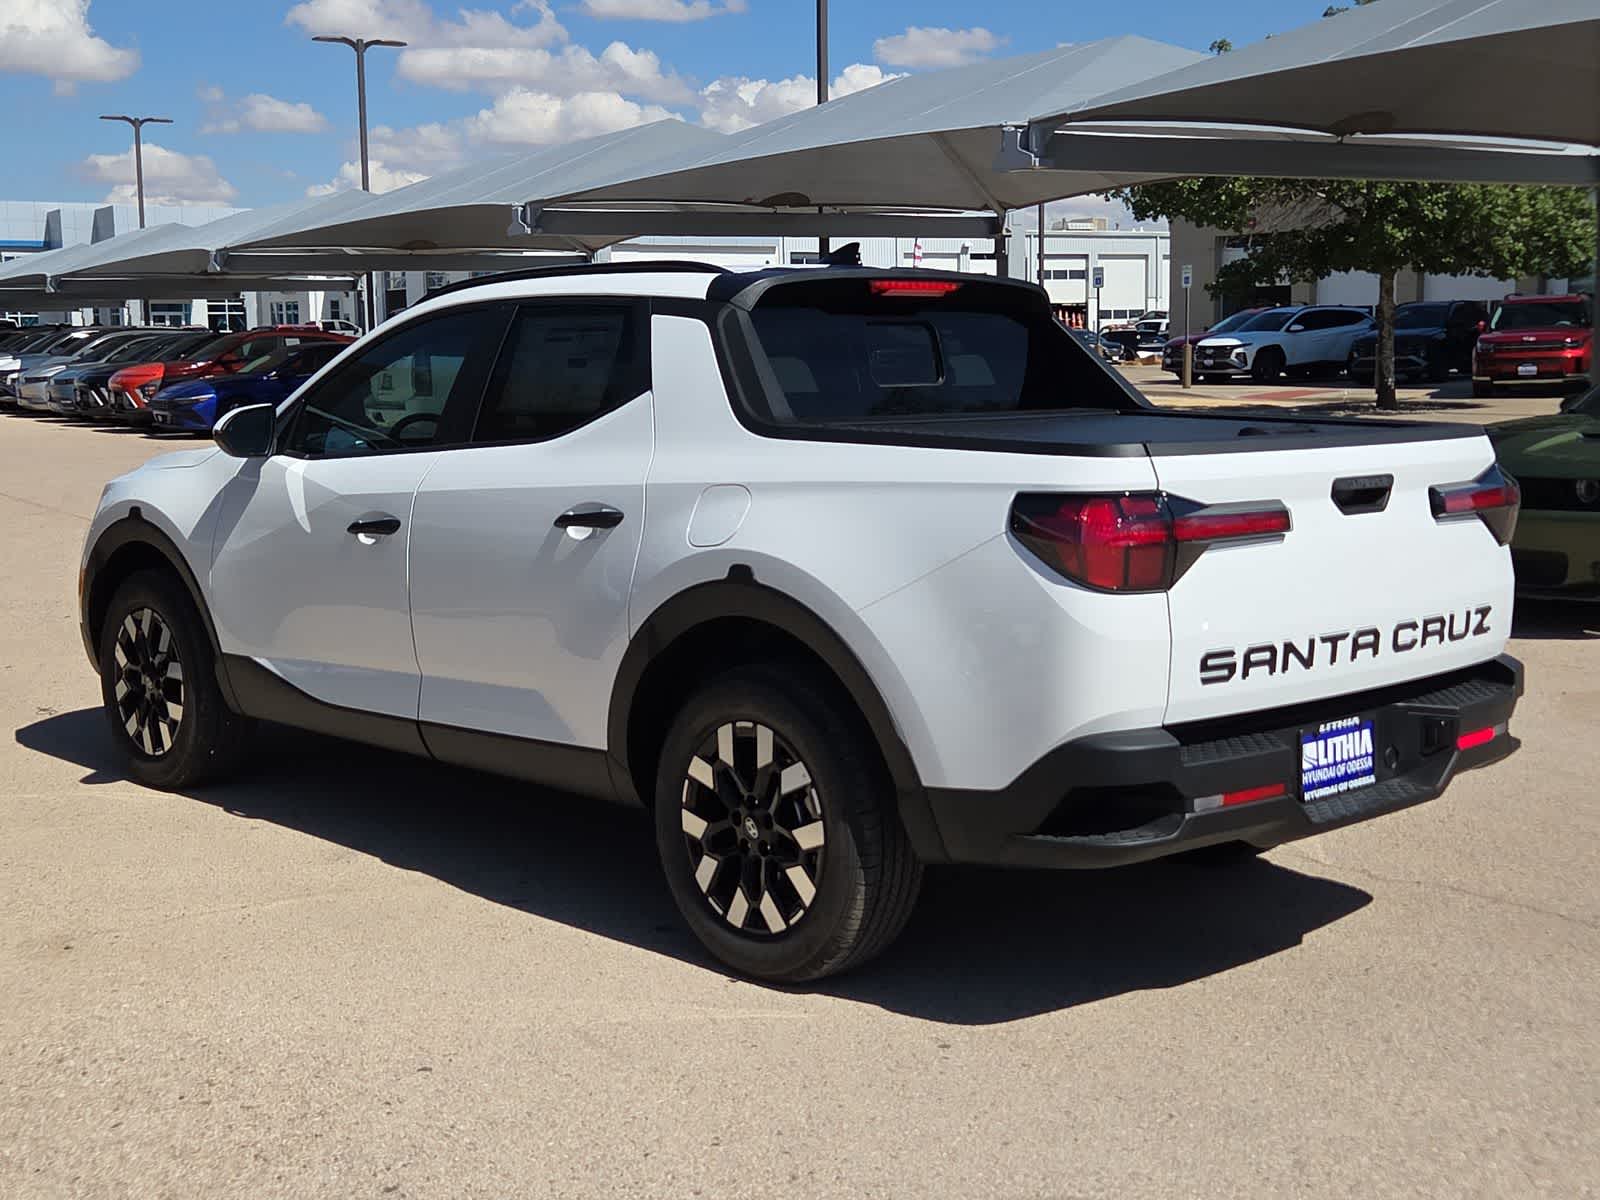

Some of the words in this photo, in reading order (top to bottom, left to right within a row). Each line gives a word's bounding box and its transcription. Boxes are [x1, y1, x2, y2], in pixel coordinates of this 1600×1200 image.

[1200, 626, 1380, 685] SANTA
[1392, 604, 1492, 653] CRUZ
[1317, 728, 1373, 767] LITHIA
[1302, 765, 1336, 786] HYUNDAI
[1336, 762, 1346, 778] OF
[1346, 755, 1373, 776] ODESSA
